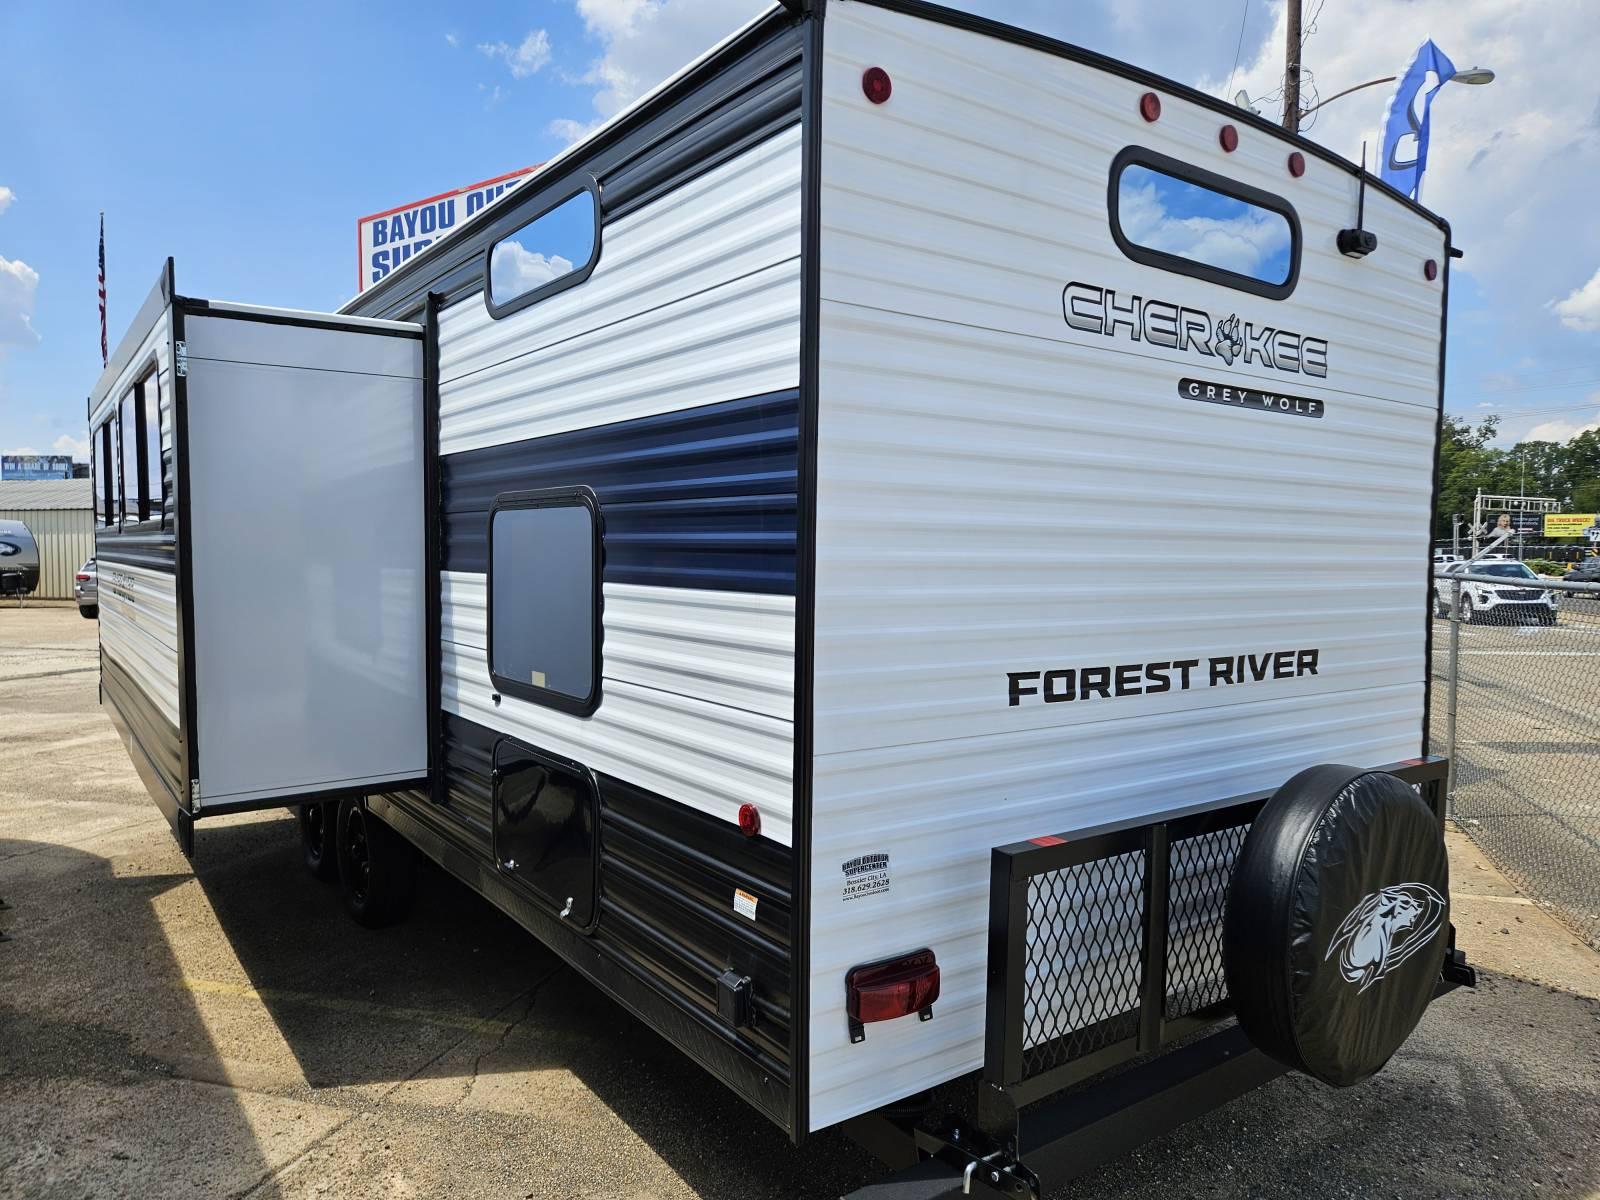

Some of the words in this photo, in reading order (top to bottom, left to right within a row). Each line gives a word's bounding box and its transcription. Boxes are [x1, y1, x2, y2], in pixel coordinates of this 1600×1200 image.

[373, 199, 455, 247] BAYOU
[1189, 383, 1247, 404] GREY
[1262, 395, 1316, 414] WOLF
[1006, 658, 1199, 707] FOREST
[1208, 649, 1319, 687] RIVER
[842, 857, 861, 872] BAYOU
[862, 854, 889, 865] OUTDOOR
[845, 862, 888, 877] SUPERCENTER
[843, 879, 890, 895] 318.629.2628
[847, 877, 867, 886] Bossier
